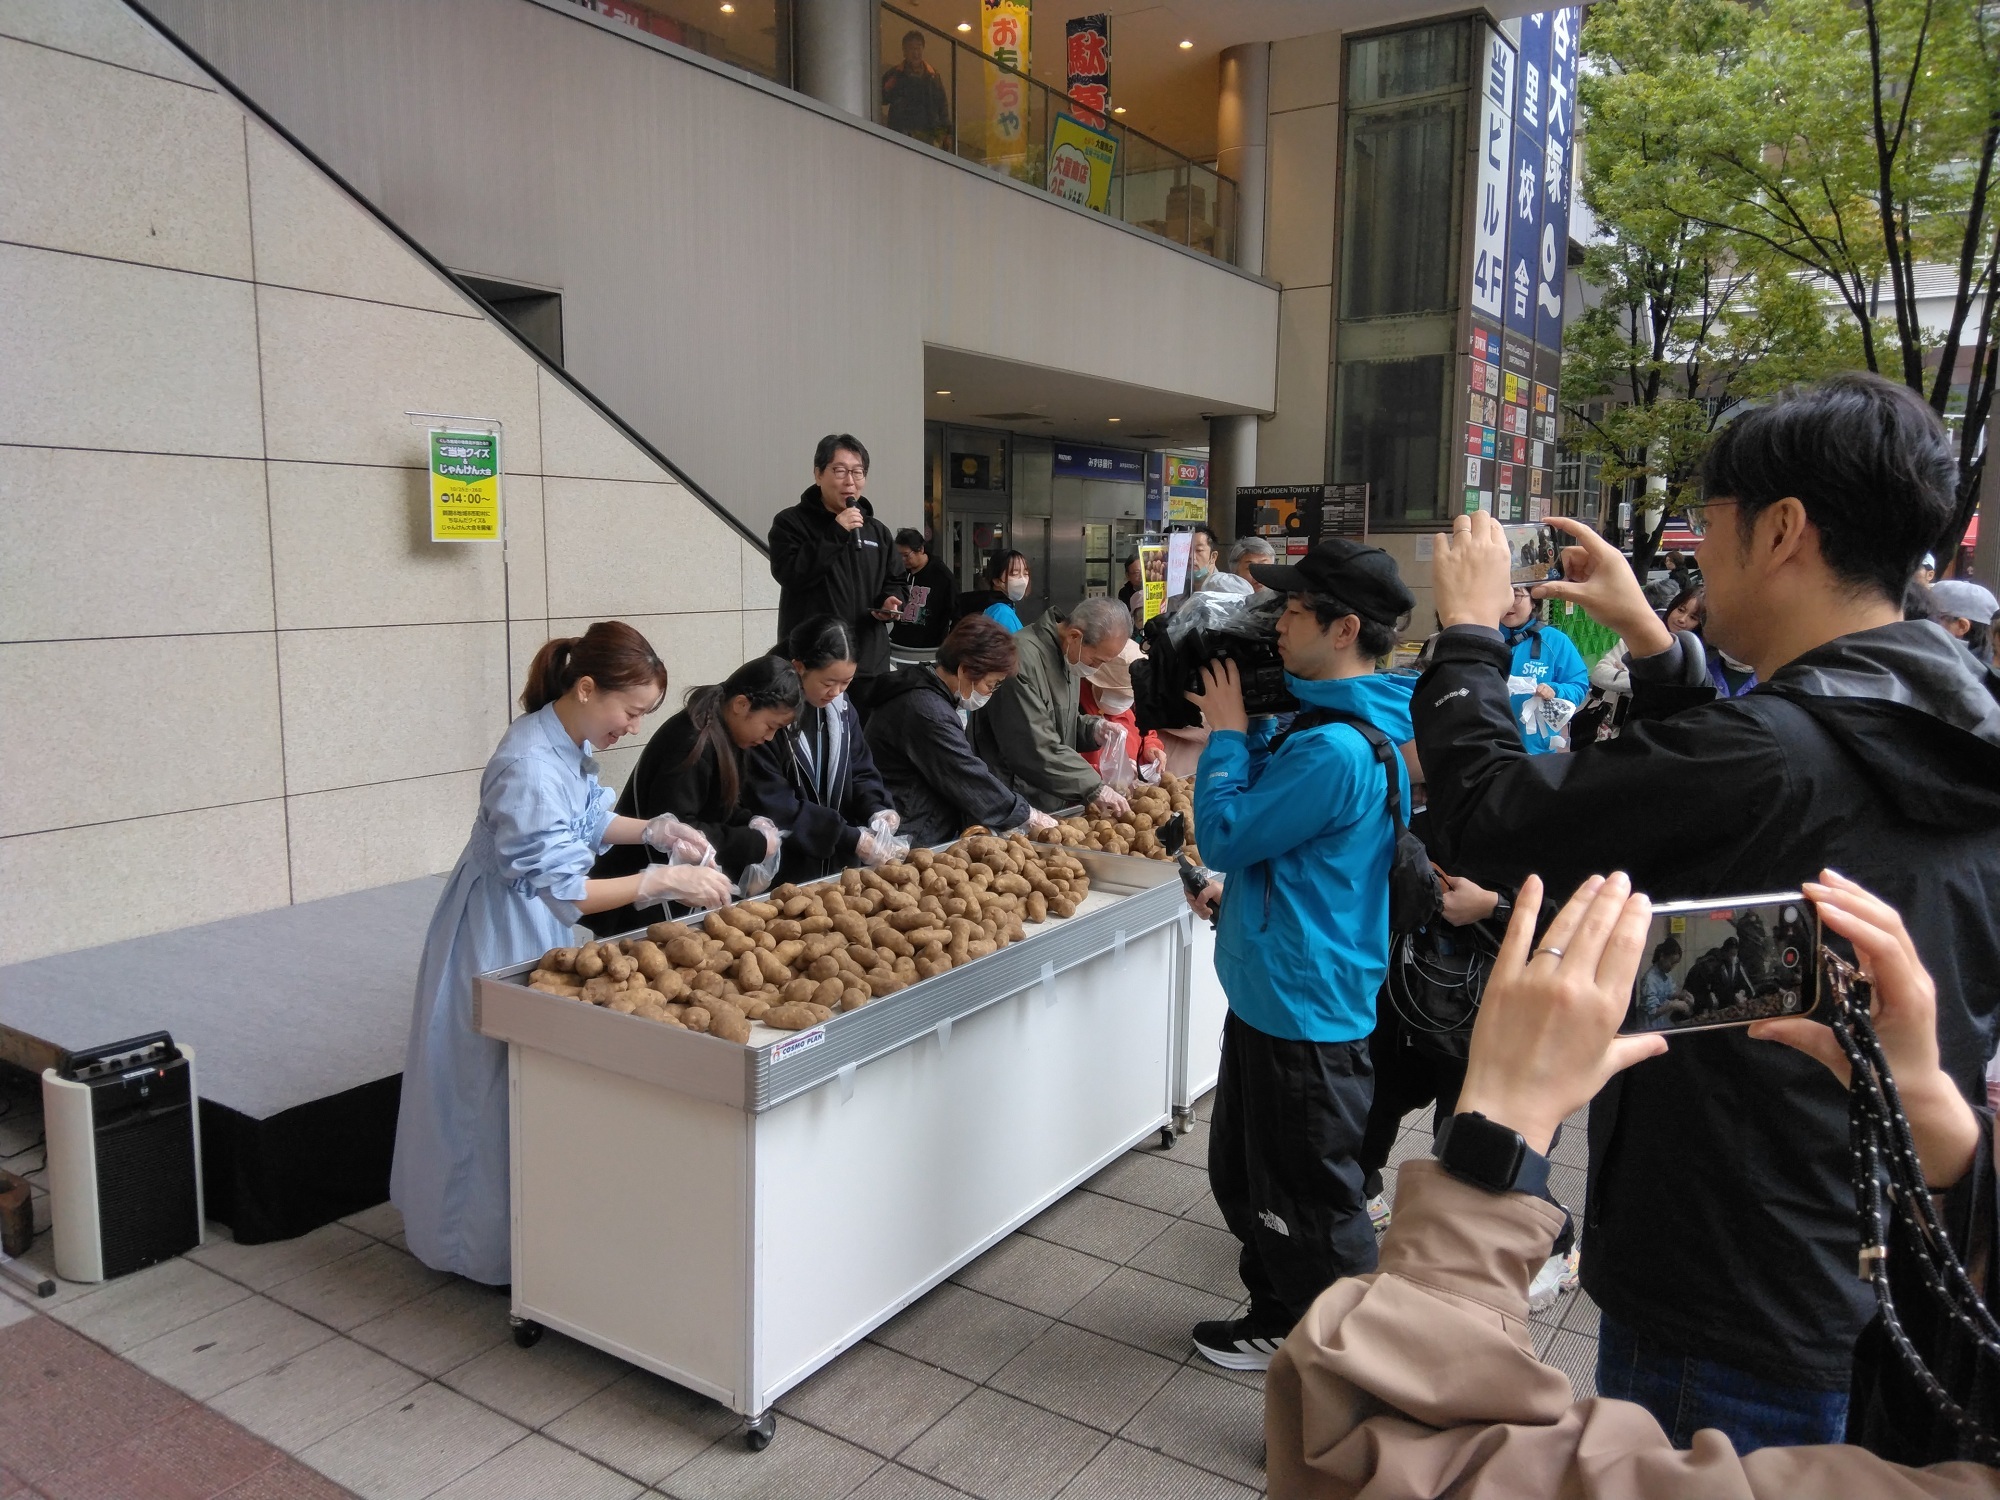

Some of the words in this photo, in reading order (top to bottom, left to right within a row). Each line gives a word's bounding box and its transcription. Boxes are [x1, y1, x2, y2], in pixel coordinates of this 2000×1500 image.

[991, 17, 1020, 137] おもちゃ
[1473, 40, 1508, 306] 当ビル4F
[1514, 13, 1543, 321] 里校舎
[440, 446, 490, 458] ご当地クイズ
[440, 464, 492, 475] じゃんけん大会
[1088, 458, 1113, 469] みずほ銀行
[1180, 467, 1195, 478] 宝くじ
[1289, 486, 1310, 494] TOWER
[1522, 662, 1549, 678] STAFF
[1434, 690, 1459, 708] GORE-TEX
[782, 1042, 805, 1055] COSMO
[806, 1033, 823, 1045] PLAN
